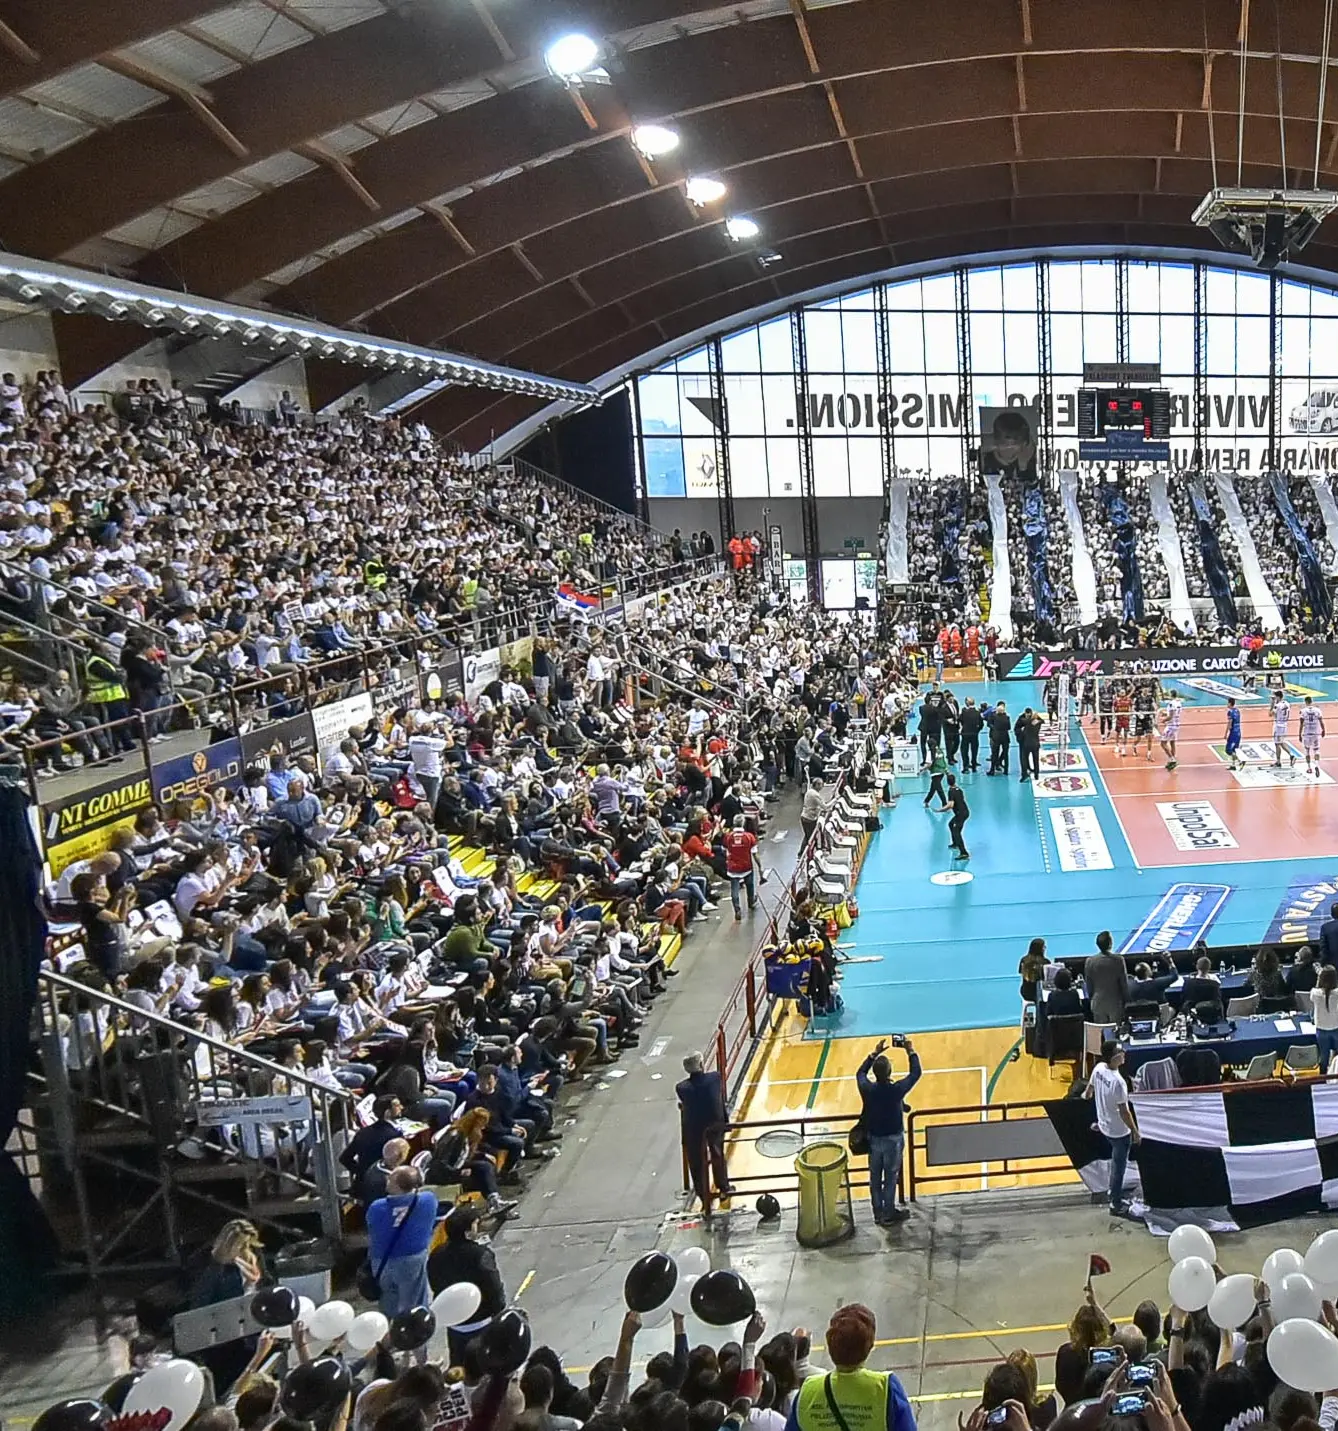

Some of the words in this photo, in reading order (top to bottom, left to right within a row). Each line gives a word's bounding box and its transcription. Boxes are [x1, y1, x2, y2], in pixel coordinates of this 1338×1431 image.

[160, 762, 239, 804] OREGOLD
[60, 802, 88, 829] NT
[1166, 802, 1231, 849] UnipolSai
[1279, 922, 1309, 943] JU
[392, 1206, 409, 1228] 7
